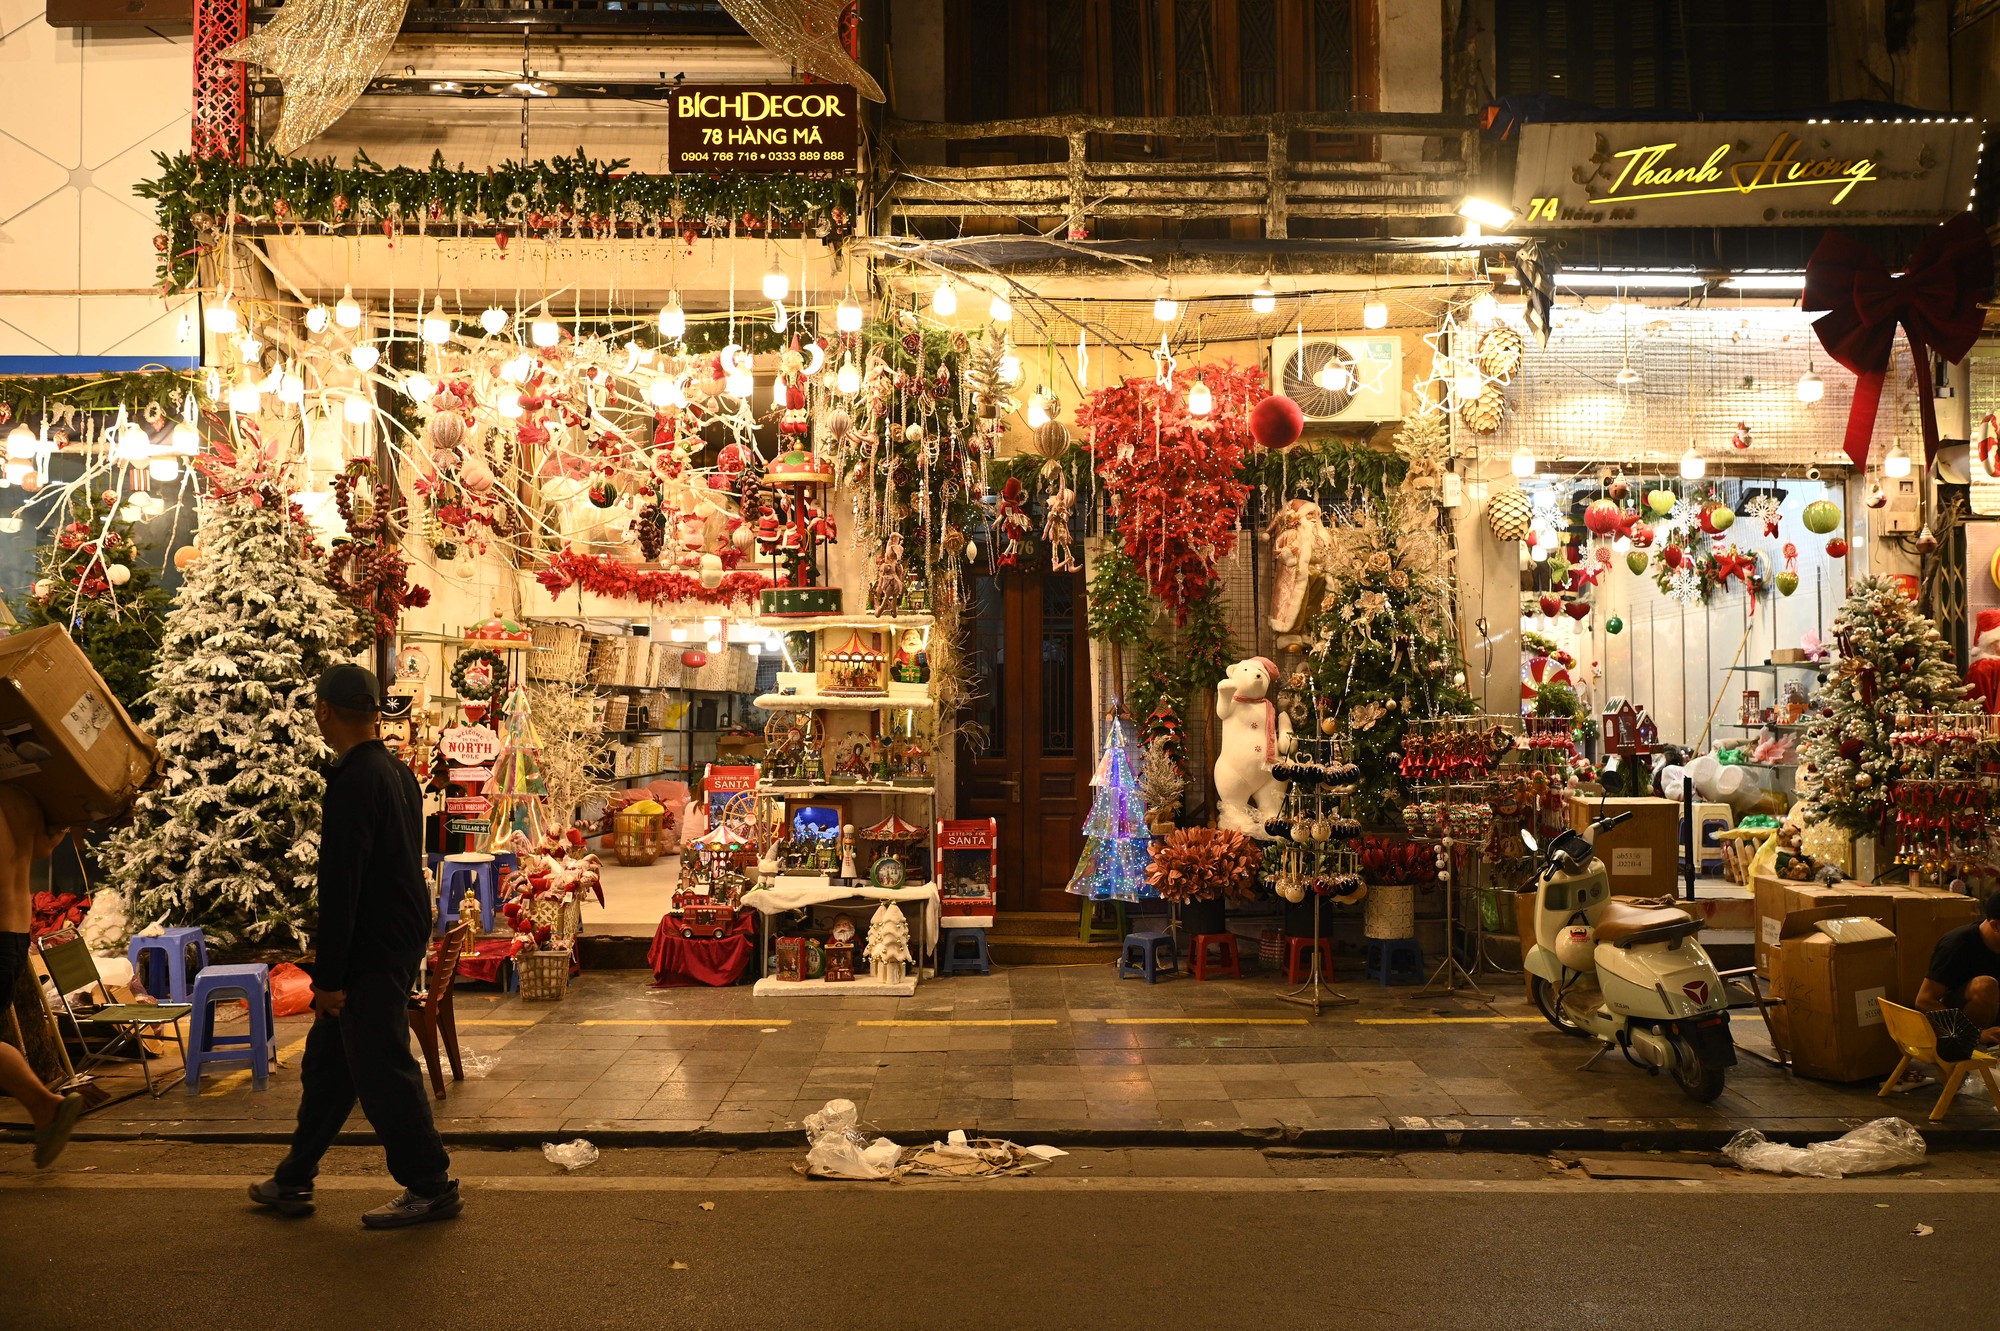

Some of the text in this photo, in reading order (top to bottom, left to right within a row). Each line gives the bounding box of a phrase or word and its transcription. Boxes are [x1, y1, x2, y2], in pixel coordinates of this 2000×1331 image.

[701, 124, 823, 145] 78 HÀNG MÃ
[681, 151, 845, 161] 0904 766 716 0333 889 888
[1607, 131, 1877, 206] Thanh Hương
[1527, 197, 1559, 222] 74
[1017, 540, 1034, 555] 76
[456, 729, 485, 741] WELCOME
[448, 741, 493, 754] NORTH
[948, 836, 986, 844] SANTA
